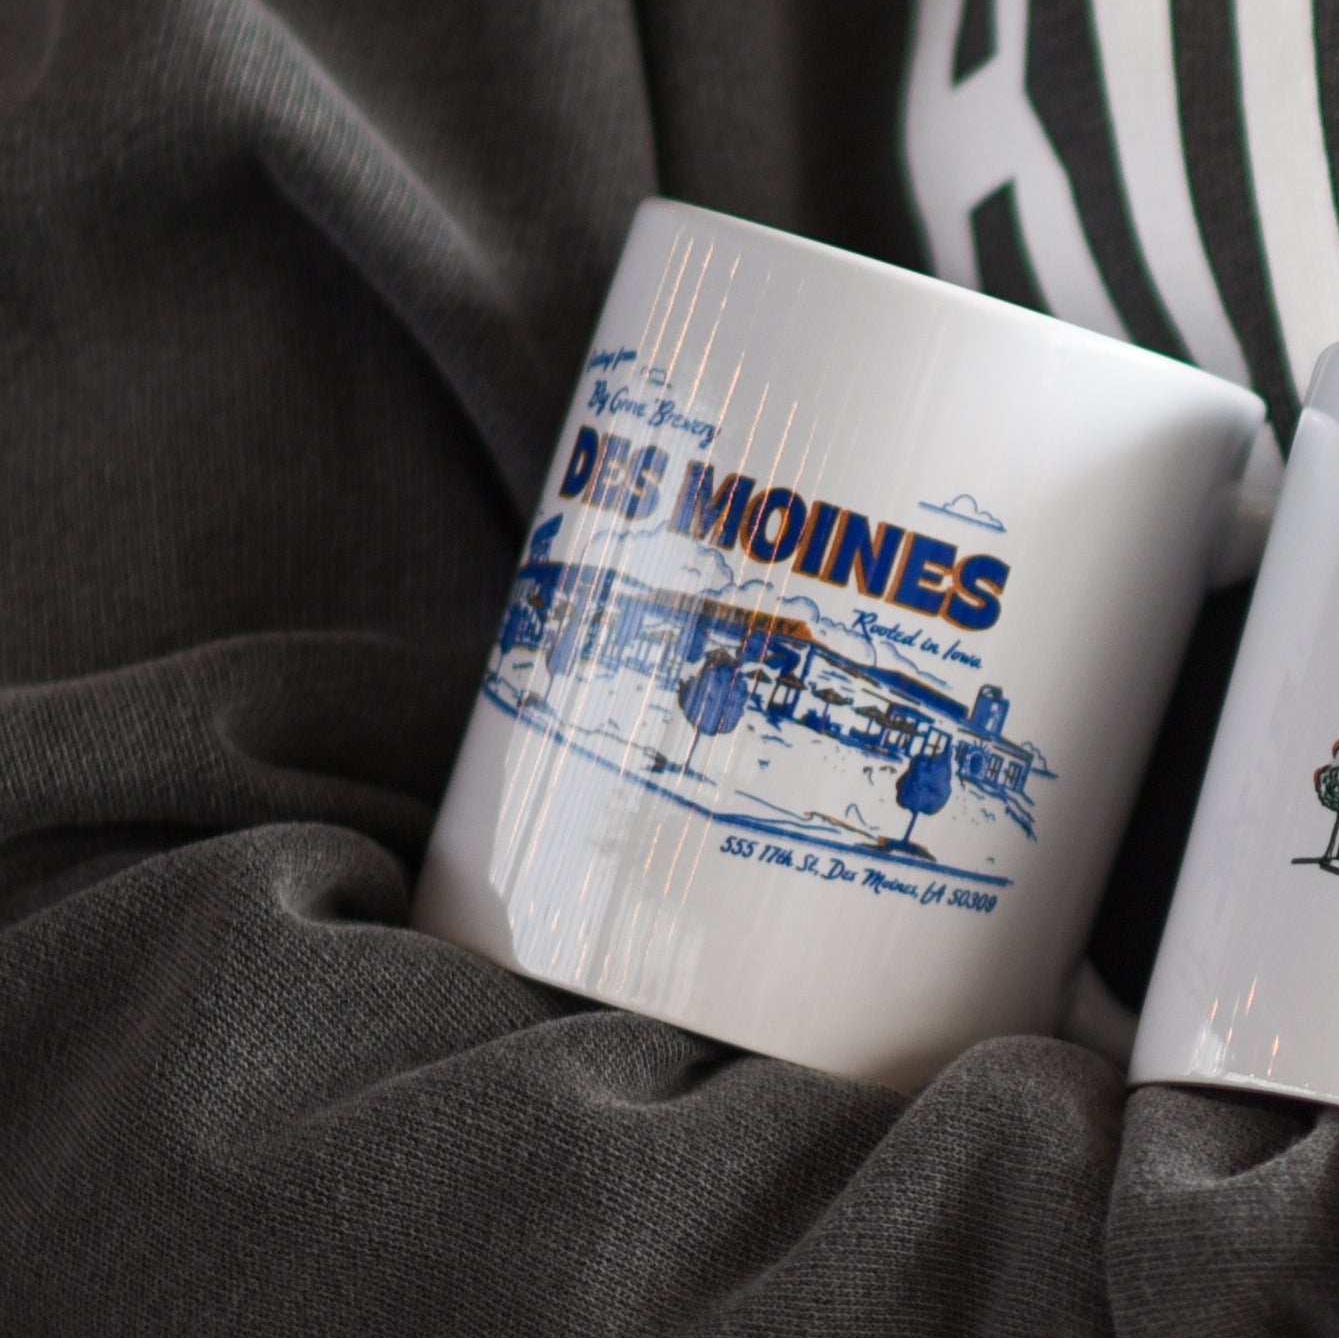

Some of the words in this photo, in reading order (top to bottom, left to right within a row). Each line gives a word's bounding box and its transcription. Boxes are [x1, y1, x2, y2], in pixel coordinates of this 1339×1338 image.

[559, 425, 669, 522] DES
[667, 459, 1011, 631] MOINES
[852, 609, 918, 644] Rooted
[920, 637, 939, 654] in
[943, 641, 982, 669] Iowa
[720, 835, 755, 859] 555
[758, 844, 793, 867] 17th
[820, 858, 856, 881] Des
[947, 888, 998, 912] 50309
